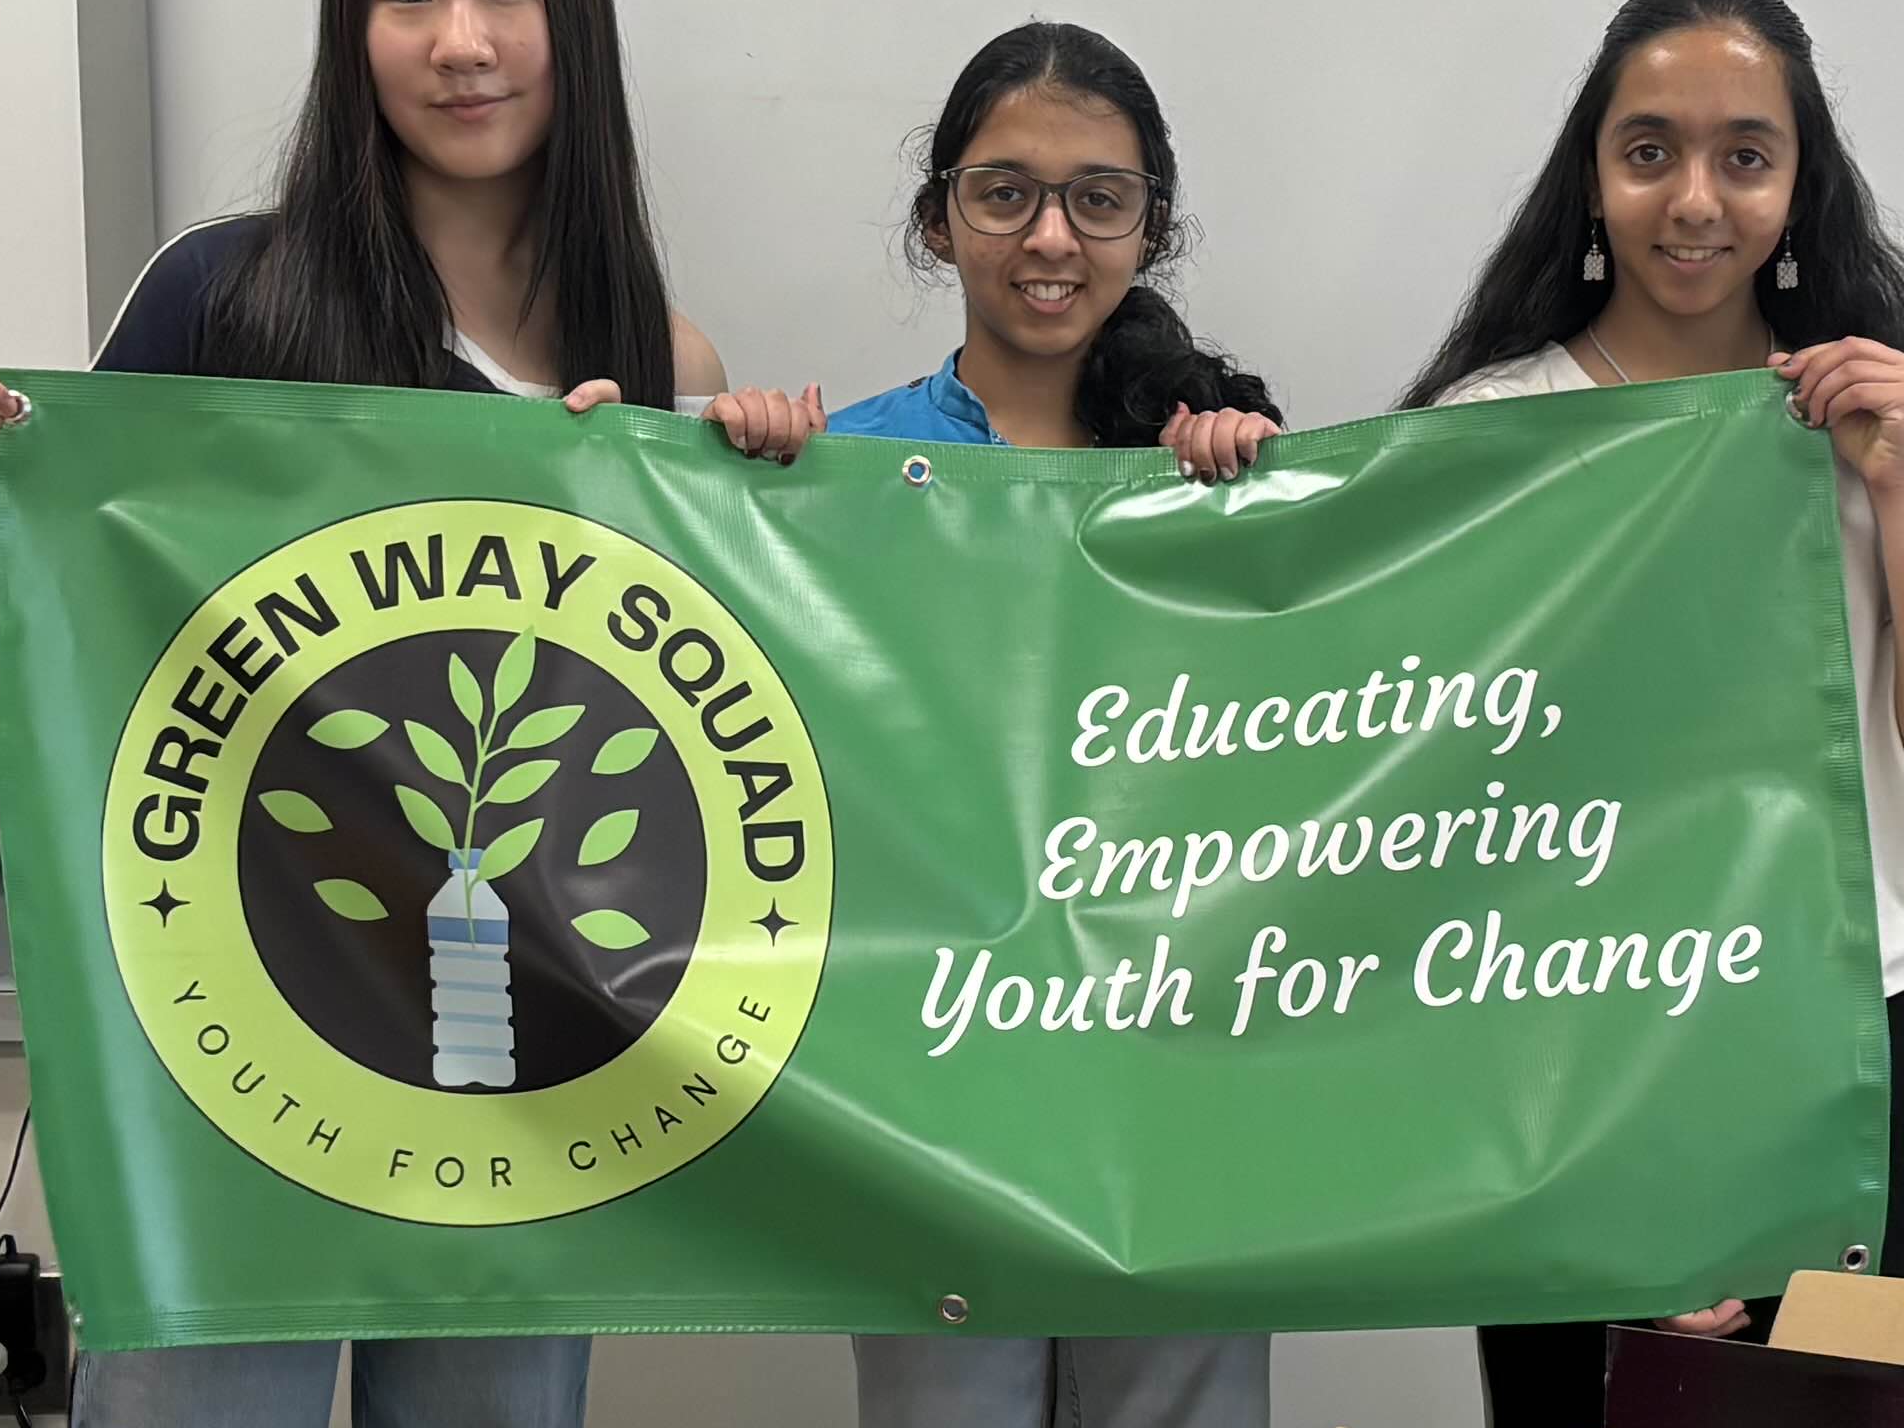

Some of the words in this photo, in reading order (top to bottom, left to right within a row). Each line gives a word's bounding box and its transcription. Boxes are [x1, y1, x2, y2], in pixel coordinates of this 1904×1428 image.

[132, 573, 342, 863] GREEN
[350, 533, 597, 612] WAY
[606, 584, 807, 885] SQUAD
[1070, 654, 1563, 767] Educating,
[1037, 780, 1623, 919] Empowering
[920, 934, 1194, 1058] Youth
[1230, 924, 1380, 1038] for
[1412, 910, 1763, 1018] Change
[173, 979, 345, 1155] YOUTH
[388, 1148, 513, 1189] FOR
[567, 993, 771, 1172] CHANGE
